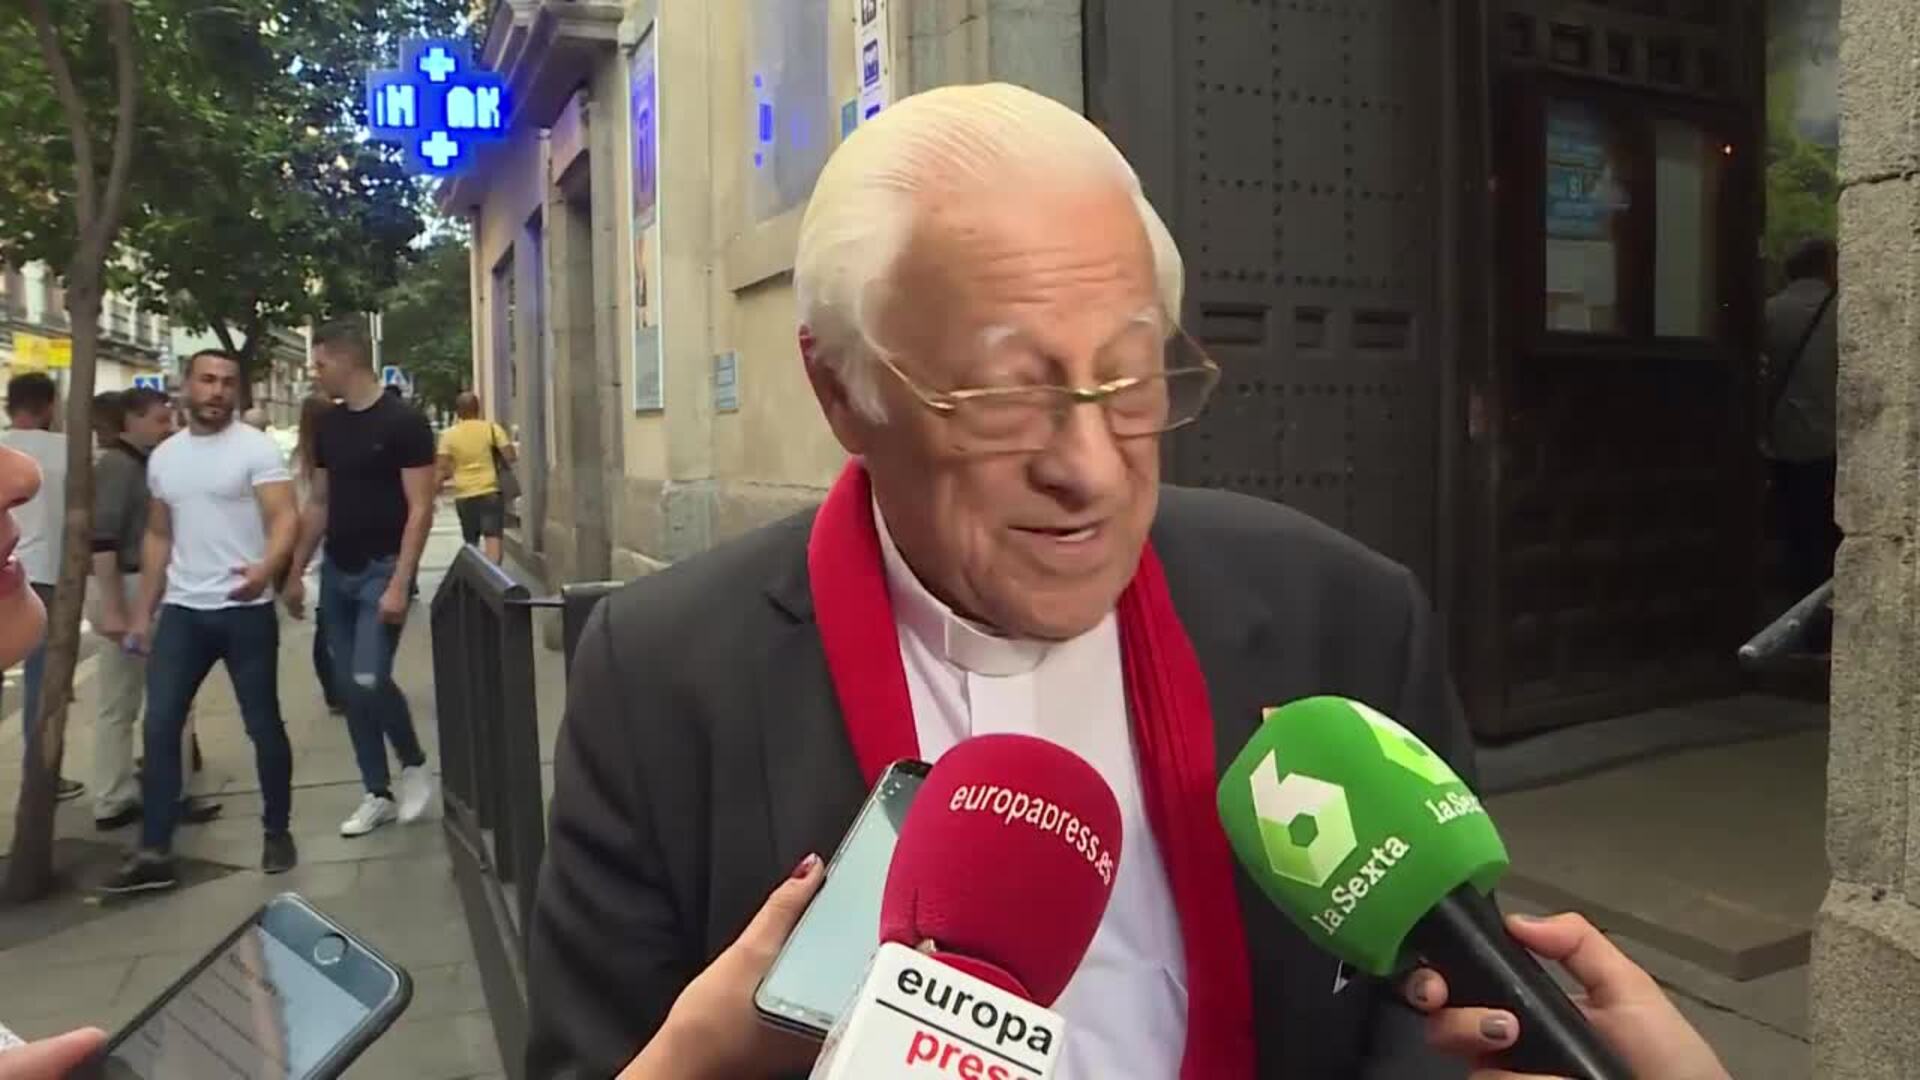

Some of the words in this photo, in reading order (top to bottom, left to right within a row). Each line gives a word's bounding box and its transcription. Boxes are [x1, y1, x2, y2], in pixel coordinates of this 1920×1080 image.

[949, 785, 1114, 886] europapress.es
[897, 967, 1053, 1055] europa
[905, 1029, 1030, 1080] pres
